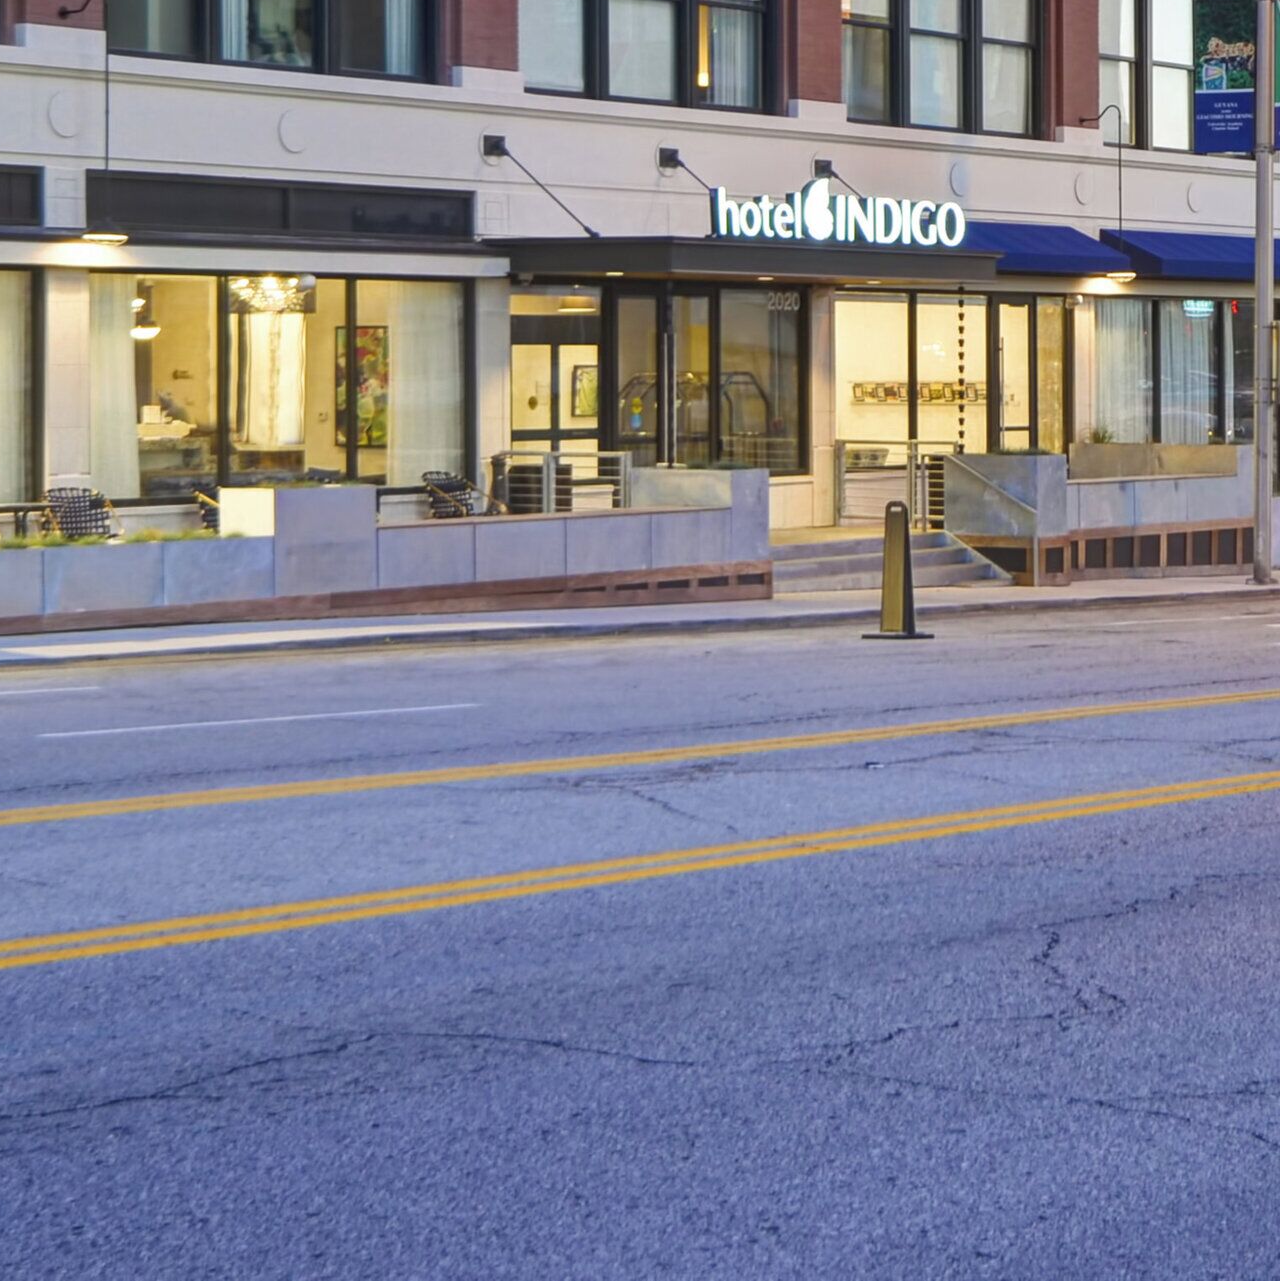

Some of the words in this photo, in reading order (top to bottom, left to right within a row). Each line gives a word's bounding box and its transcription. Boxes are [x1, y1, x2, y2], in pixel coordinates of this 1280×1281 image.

[718, 186, 803, 239] hotel
[835, 194, 966, 247] INDIGO
[768, 291, 800, 310] 2020
